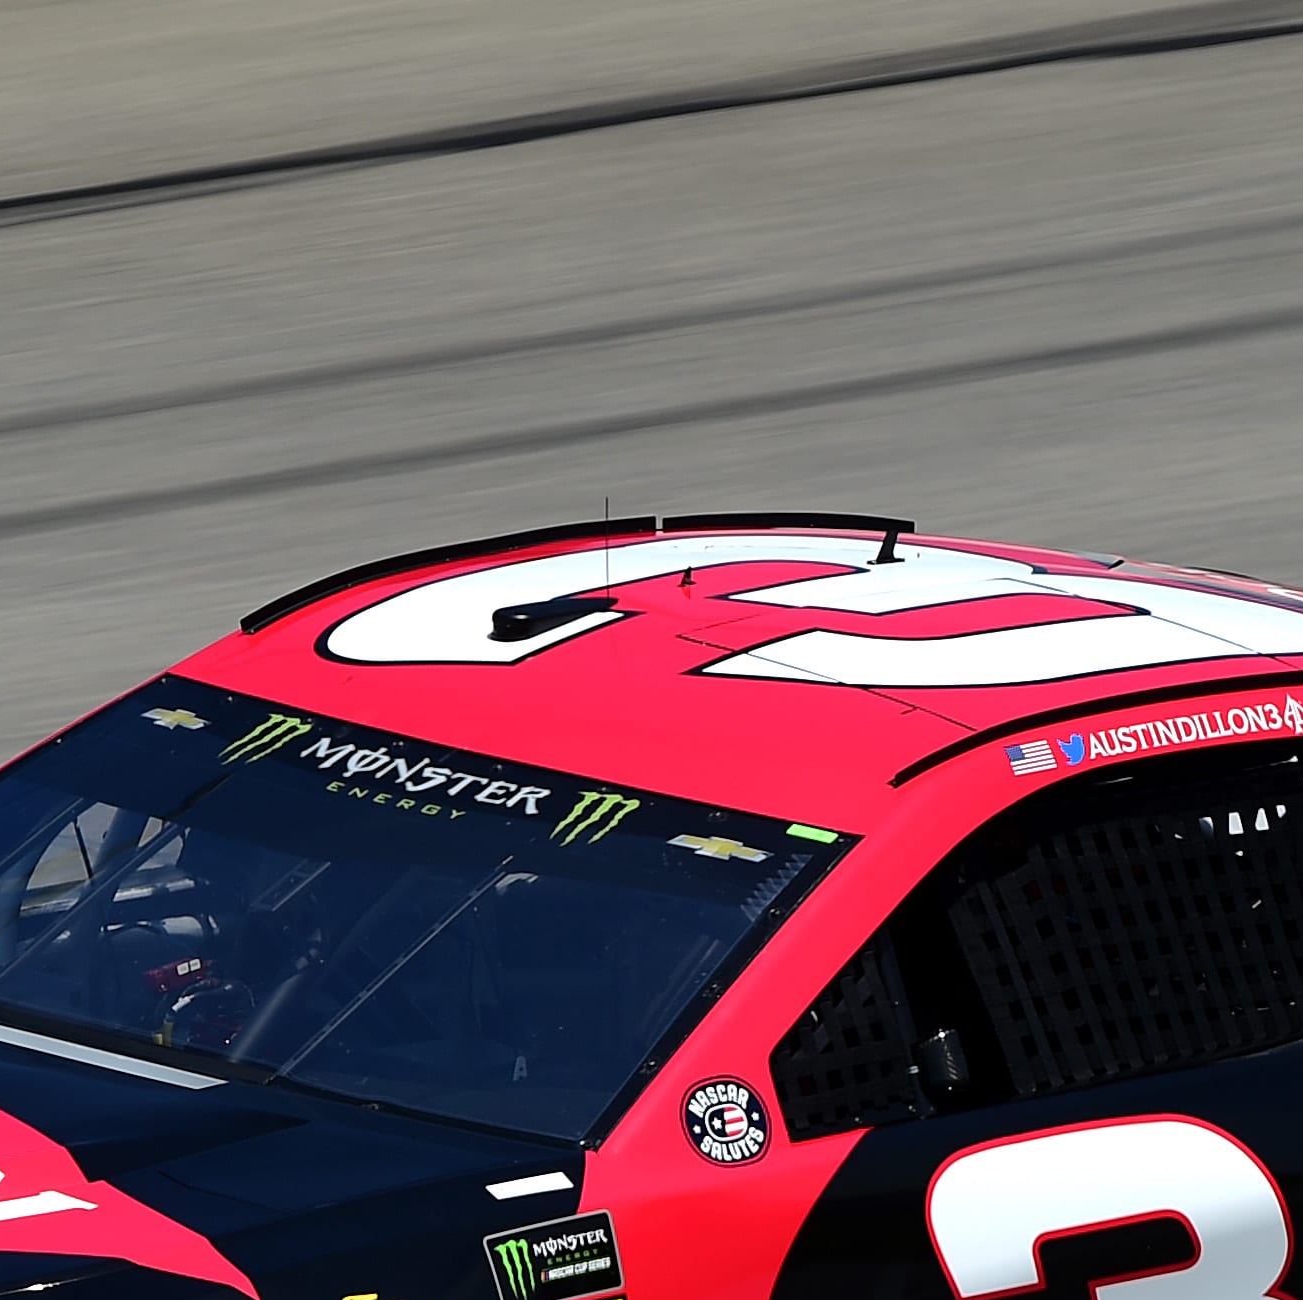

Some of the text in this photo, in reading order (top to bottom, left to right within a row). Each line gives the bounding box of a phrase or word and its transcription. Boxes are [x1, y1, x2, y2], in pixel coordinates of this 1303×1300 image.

[1090, 704, 1282, 759] AUSTINDILLON3
[326, 781, 466, 820] ENERGY
[688, 1083, 749, 1118] NASCAR
[700, 1126, 765, 1161] SALUTES
